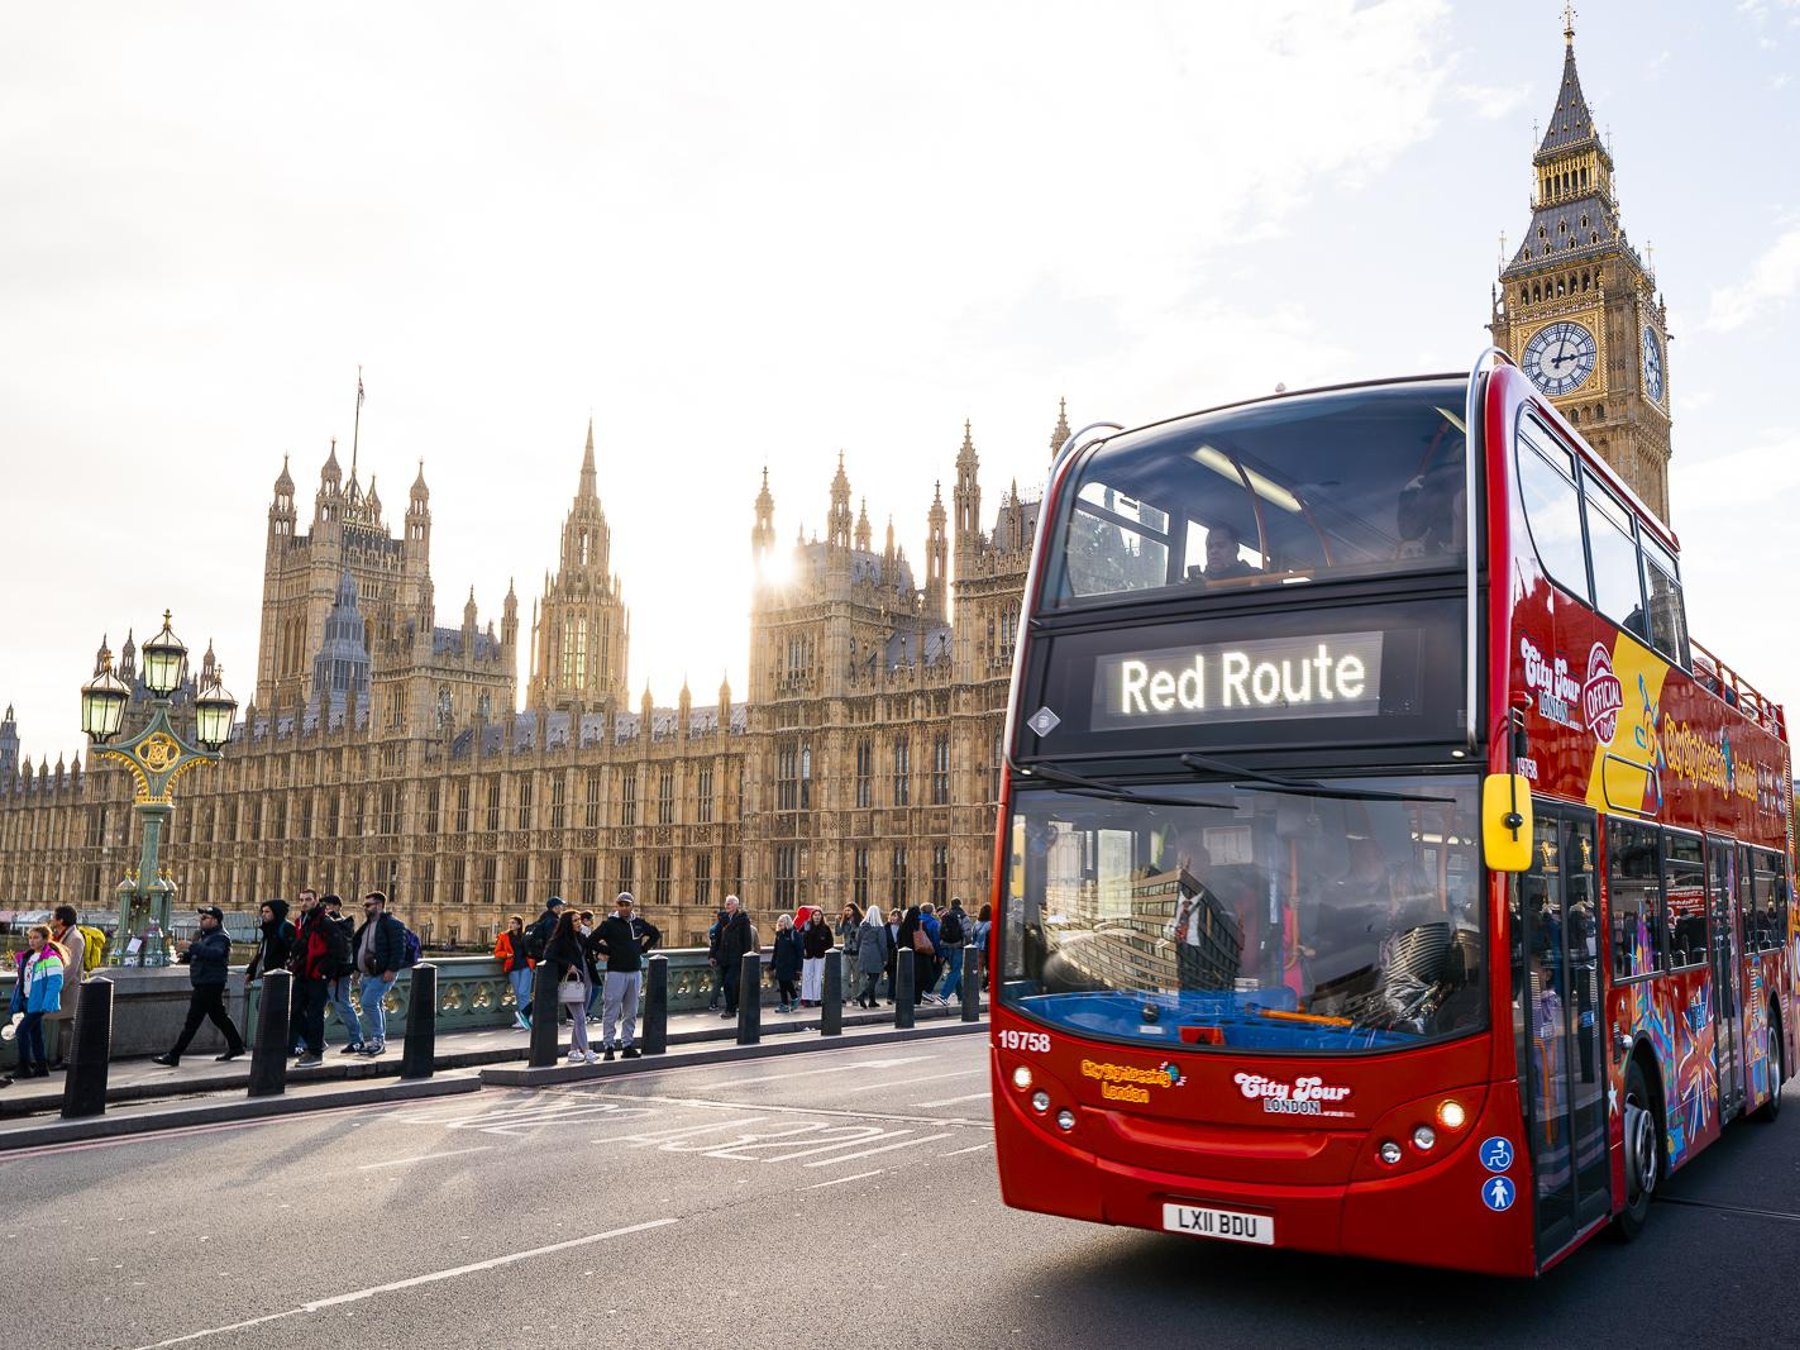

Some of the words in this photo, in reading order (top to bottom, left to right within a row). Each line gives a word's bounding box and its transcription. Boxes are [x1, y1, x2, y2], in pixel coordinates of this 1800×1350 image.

[1121, 652, 1206, 715] Red
[1222, 642, 1366, 709] Route
[1520, 637, 1553, 694] City
[1554, 657, 1581, 703] Tour
[1587, 681, 1621, 718] OFFICIAL
[1516, 757, 1538, 780] 19758
[998, 1029, 1051, 1054] 19758
[1101, 1081, 1150, 1104] London
[1234, 1072, 1289, 1100] City
[1292, 1076, 1350, 1101] Tour
[1264, 1098, 1321, 1115] LONDON
[592, 1117, 955, 1168] A3211
[1178, 1208, 1213, 1232] LX11
[1219, 1214, 1257, 1238] BDU
